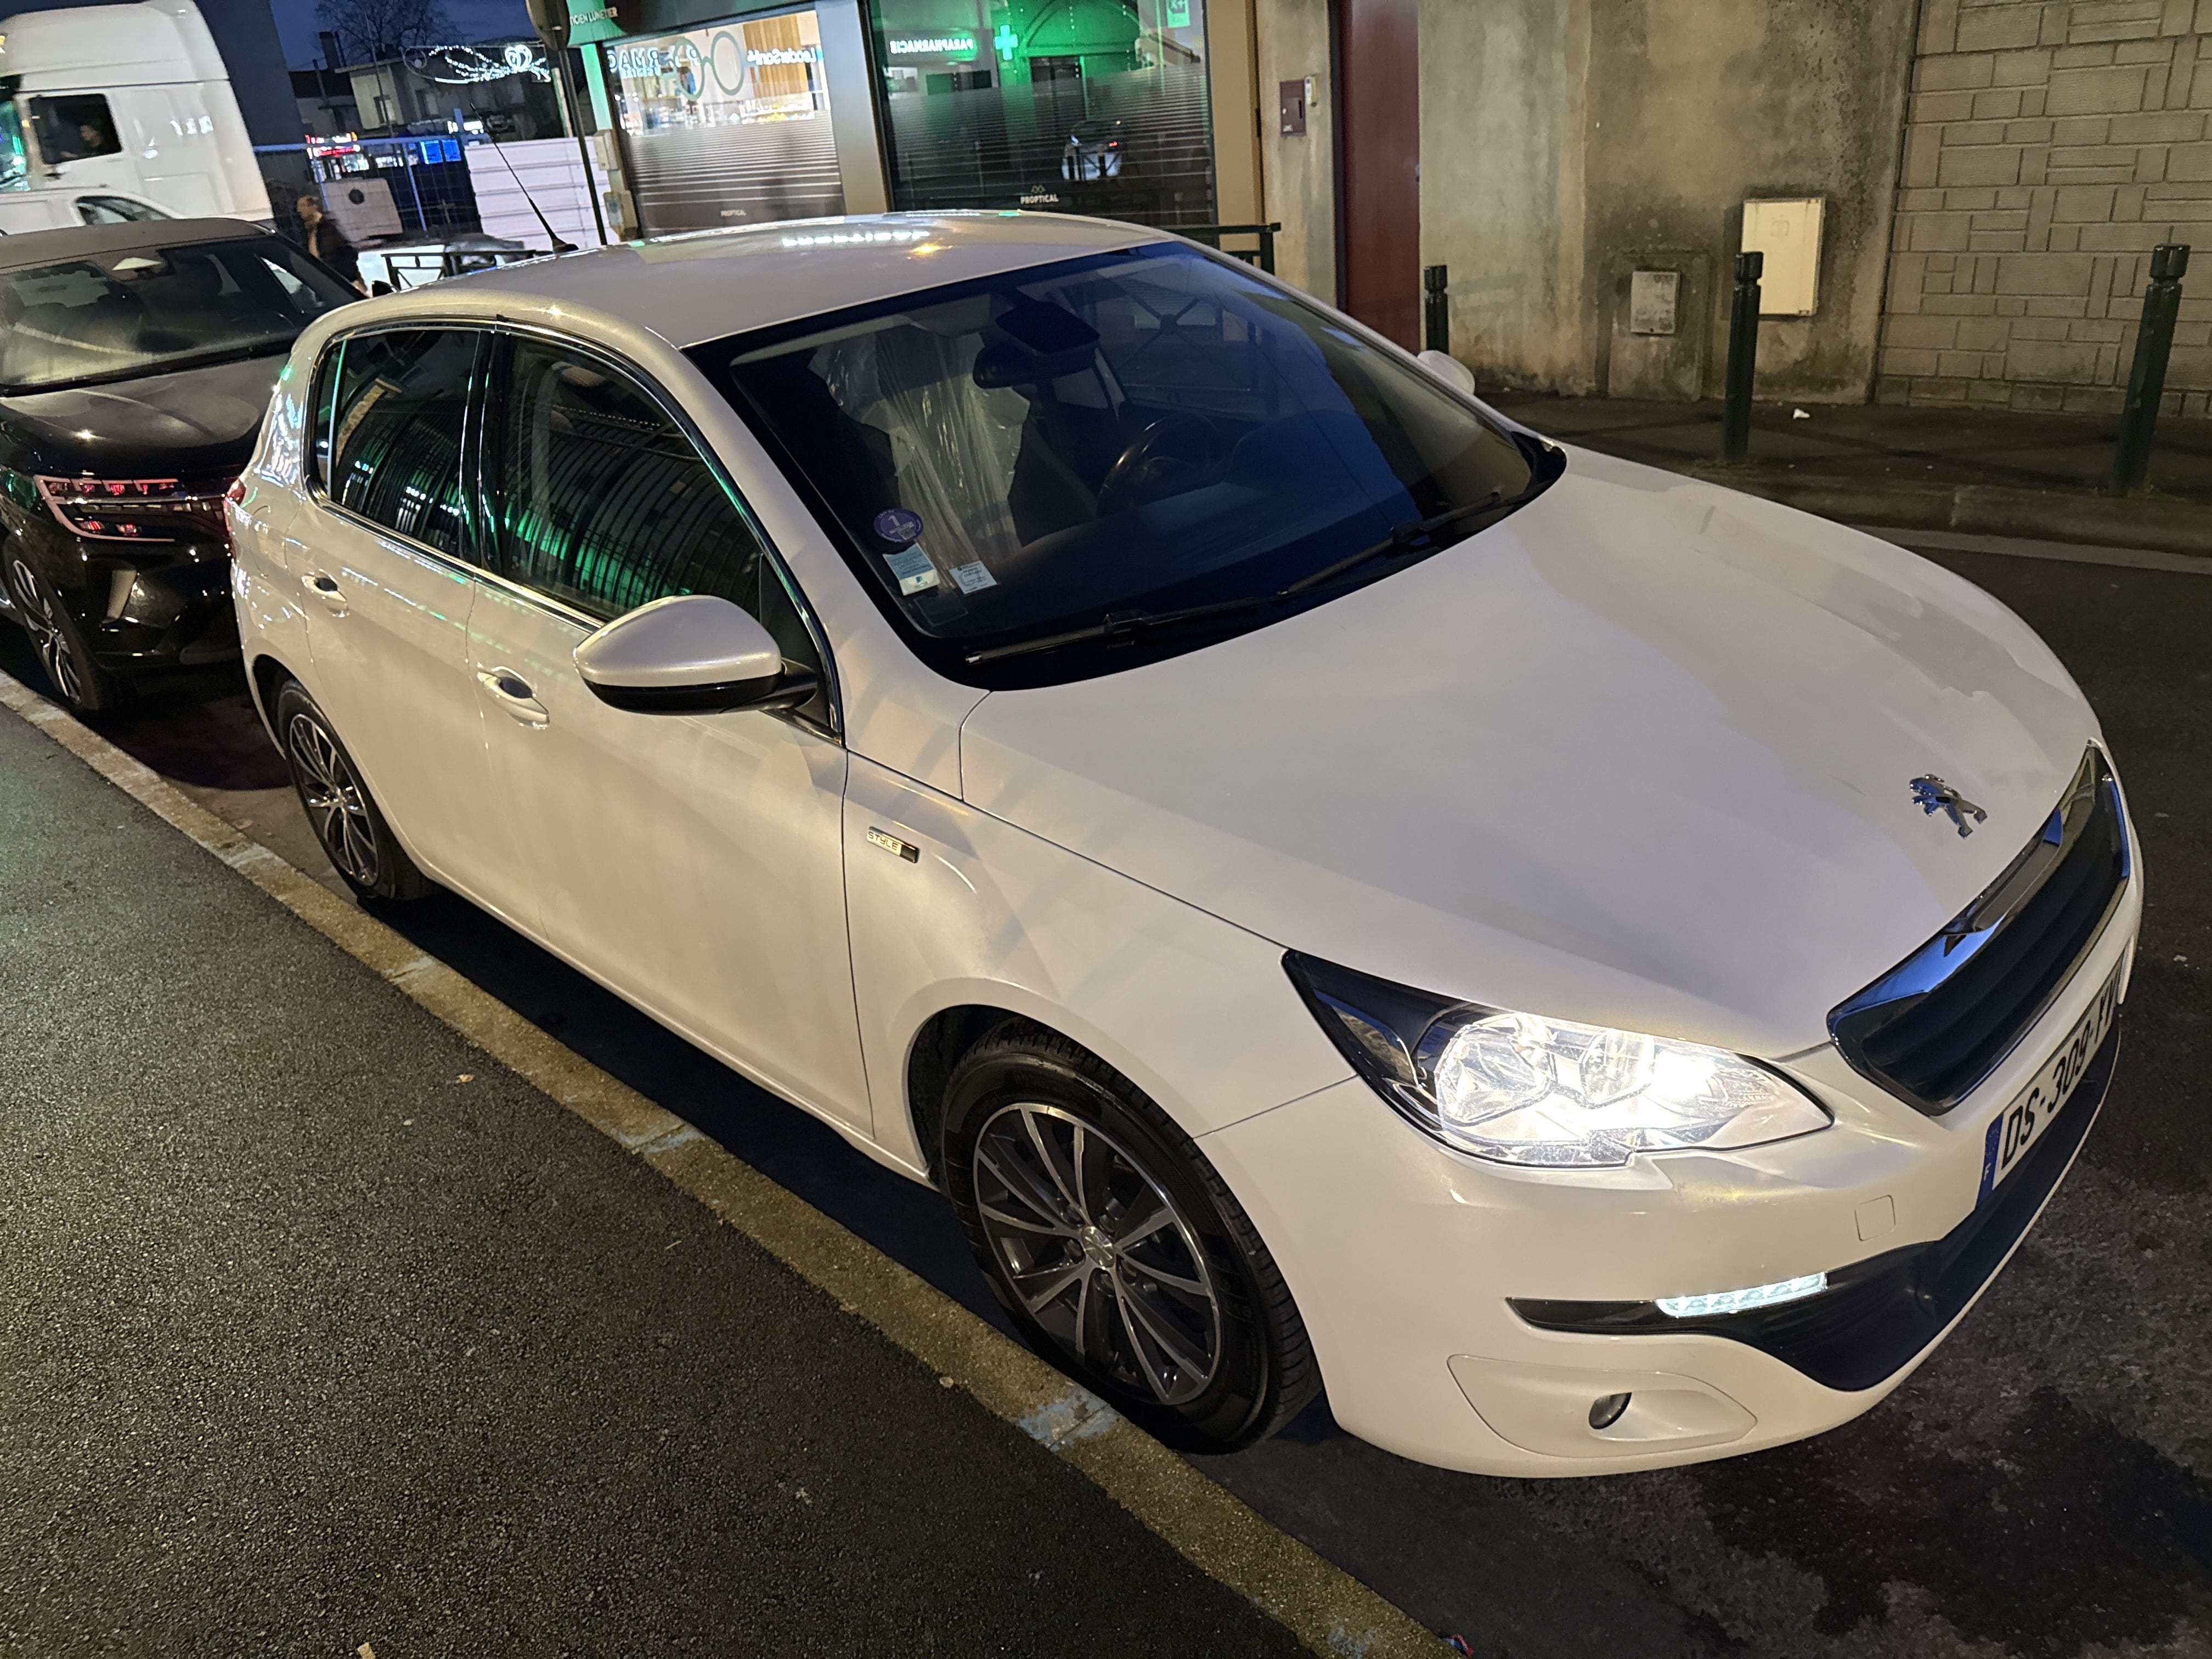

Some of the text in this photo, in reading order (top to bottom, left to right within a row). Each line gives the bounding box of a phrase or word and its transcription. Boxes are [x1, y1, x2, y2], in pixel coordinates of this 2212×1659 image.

[1020, 193, 1059, 205] PROPTICAL
[888, 515, 900, 527] 1
[868, 831, 899, 851] STYLE
[1983, 1161, 1992, 1181] F
